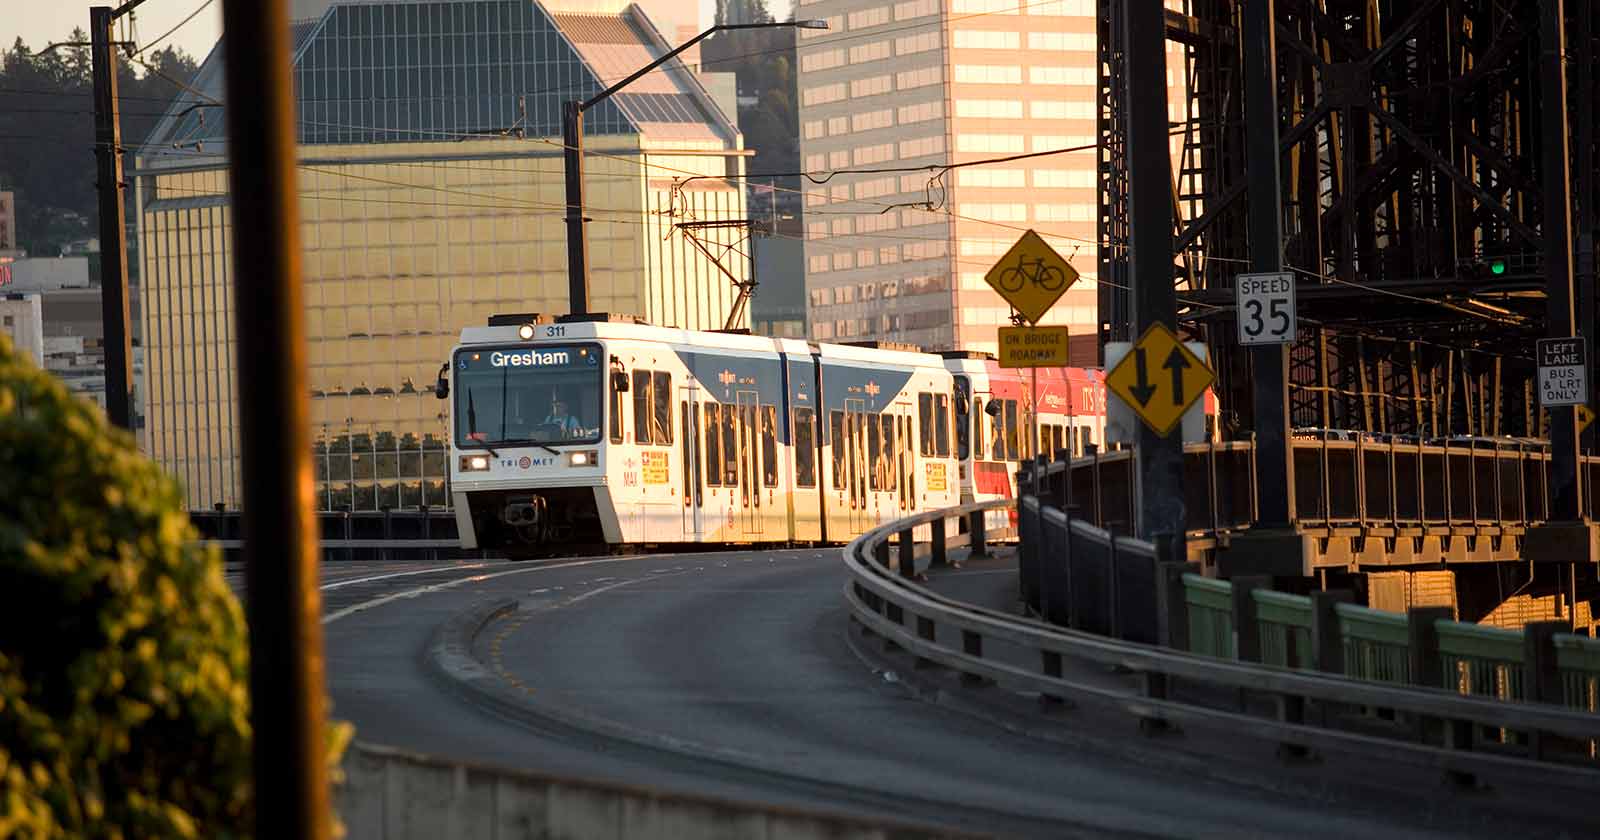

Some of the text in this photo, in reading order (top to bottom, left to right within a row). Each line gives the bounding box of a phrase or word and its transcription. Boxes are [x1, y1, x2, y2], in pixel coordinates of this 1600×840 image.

[1241, 280, 1290, 294] SPEED
[1244, 299, 1290, 336] 35
[547, 326, 565, 337] 311
[1006, 333, 1060, 344] ON BRIDGE
[1545, 343, 1576, 353] LEFT
[490, 351, 569, 367] Gresham
[1010, 349, 1056, 360] ROADWAY
[1544, 354, 1578, 365] LANE
[1550, 369, 1575, 379] BUS
[1543, 379, 1582, 390] & LRT
[1547, 390, 1579, 400] ONLY
